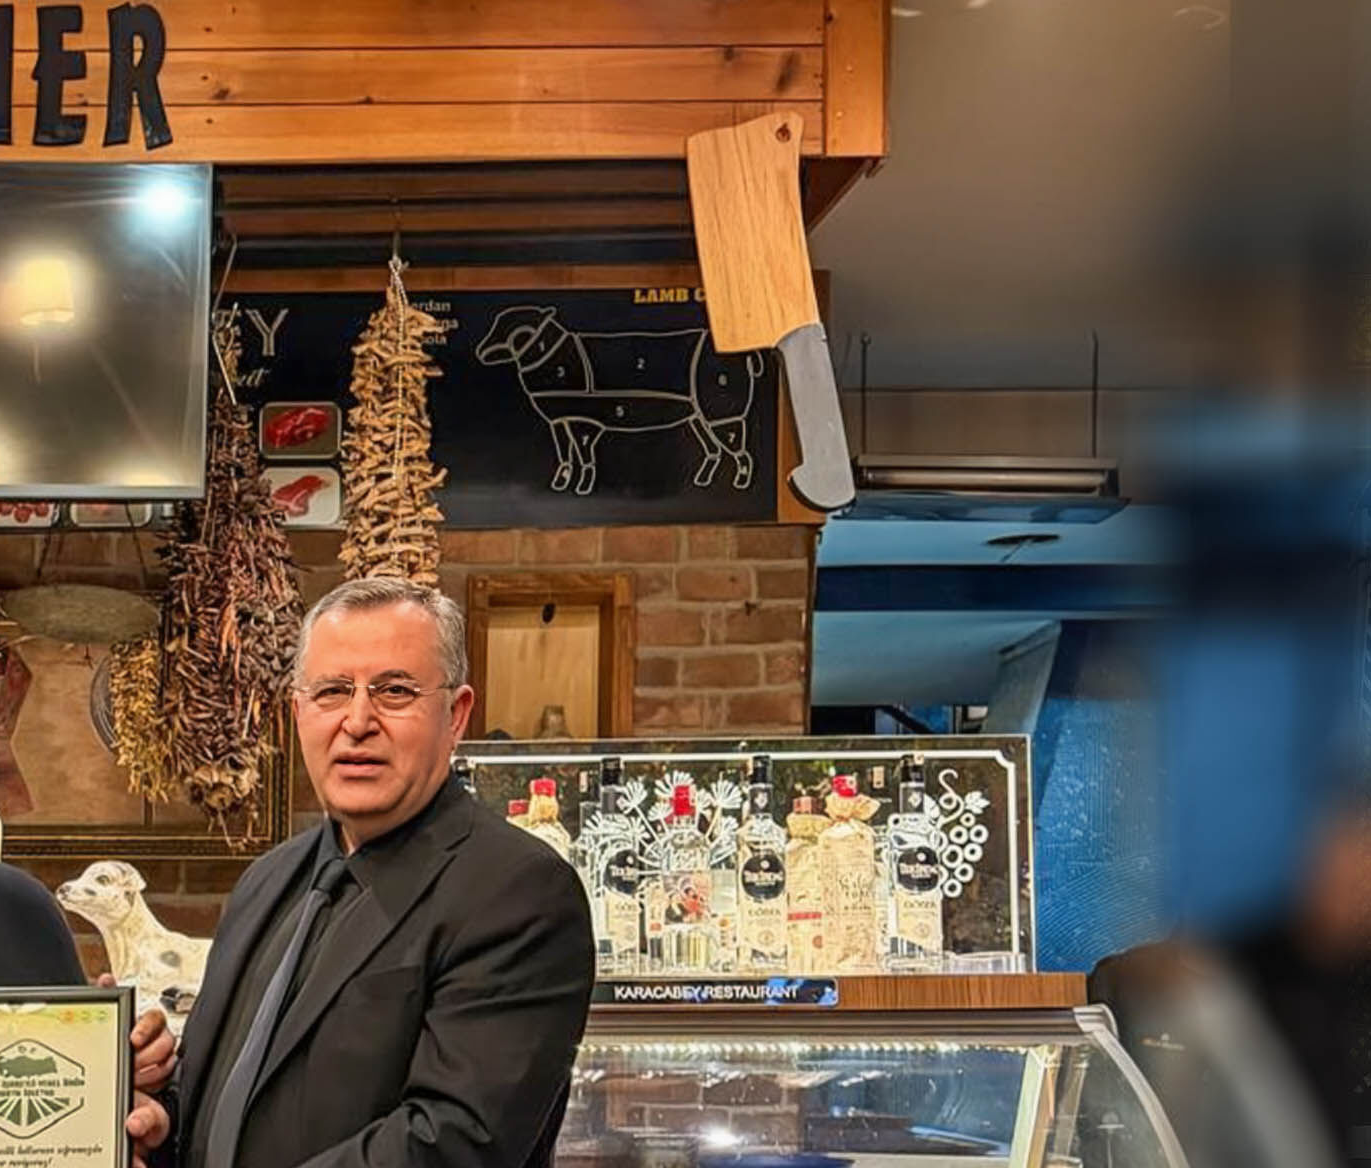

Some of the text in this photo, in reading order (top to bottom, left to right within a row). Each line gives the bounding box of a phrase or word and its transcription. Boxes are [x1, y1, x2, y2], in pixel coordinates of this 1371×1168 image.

[634, 289, 688, 303] LAMB
[614, 984, 799, 1001] KARACABEY RESTAURANT
